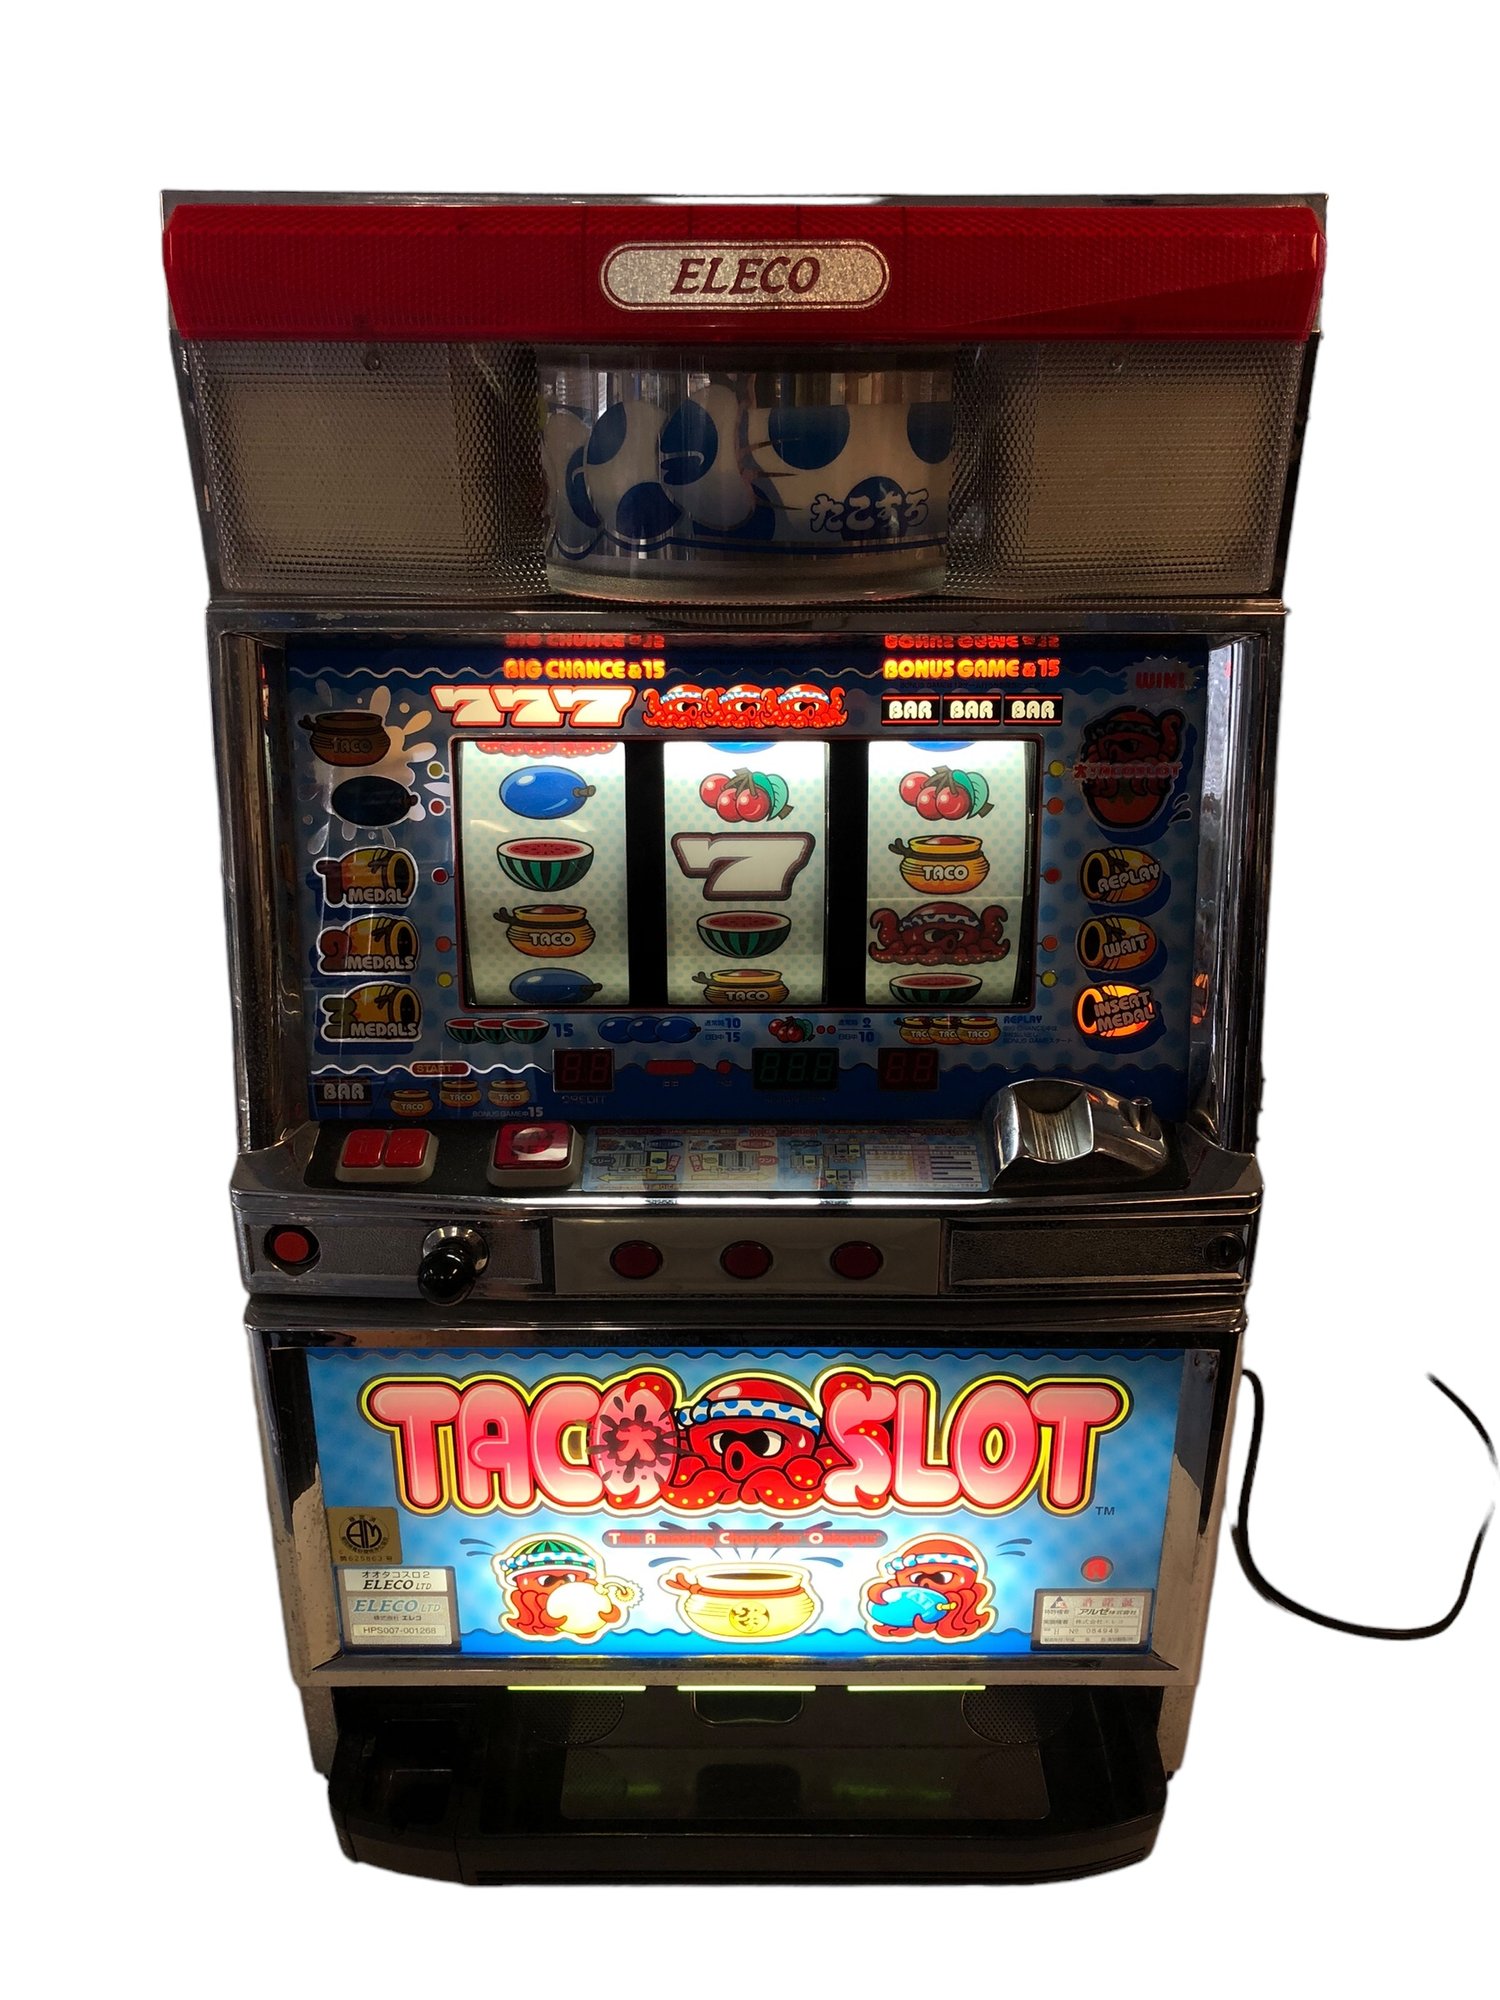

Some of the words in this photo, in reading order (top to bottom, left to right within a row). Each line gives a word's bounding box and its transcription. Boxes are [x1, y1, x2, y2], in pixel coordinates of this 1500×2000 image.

[669, 256, 822, 297] ELECO
[504, 657, 543, 680] BIG
[545, 657, 626, 680] CHANCE
[642, 657, 666, 680] 15
[883, 657, 955, 680] BONUS
[957, 657, 1020, 680] GAME
[1037, 658, 1061, 679] 15
[1135, 671, 1186, 690] WIN!
[887, 700, 933, 721] BAR
[949, 700, 994, 721] BAR
[1011, 700, 1056, 721] BAR
[330, 736, 373, 753] TACO
[921, 864, 968, 882] TACO
[1097, 863, 1161, 893] REPLAY
[347, 887, 408, 903] MEDAL
[529, 931, 577, 947] TACO
[1103, 933, 1149, 959] WAIT
[347, 955, 415, 971] MEDALS
[725, 989, 770, 1003] TACO
[1094, 990, 1151, 1018] INSERT
[725, 1017, 741, 1029] 10
[1003, 1015, 1043, 1024] REPLAY
[1096, 1006, 1156, 1034] MEDAL
[350, 1022, 418, 1037] MEDALS
[553, 1023, 574, 1038] 15
[725, 1031, 741, 1043] 15
[858, 1031, 875, 1043] 10
[967, 1030, 990, 1039] TACO
[416, 1063, 453, 1074] START
[323, 1082, 365, 1100] BAR
[449, 1093, 472, 1102] TACO
[498, 1093, 521, 1102] TACO
[400, 1102, 424, 1112] TACO
[529, 1106, 544, 1118] 15
[366, 1376, 677, 1510] TACO
[823, 1376, 1121, 1510] SLOT
[1096, 1506, 1116, 1516] TM
[362, 1570, 431, 1580] オオタコスロ2
[363, 1579, 414, 1591] ELECO
[415, 1582, 432, 1590] LTD
[353, 1599, 419, 1613] ELECO
[421, 1604, 441, 1613] LTD
